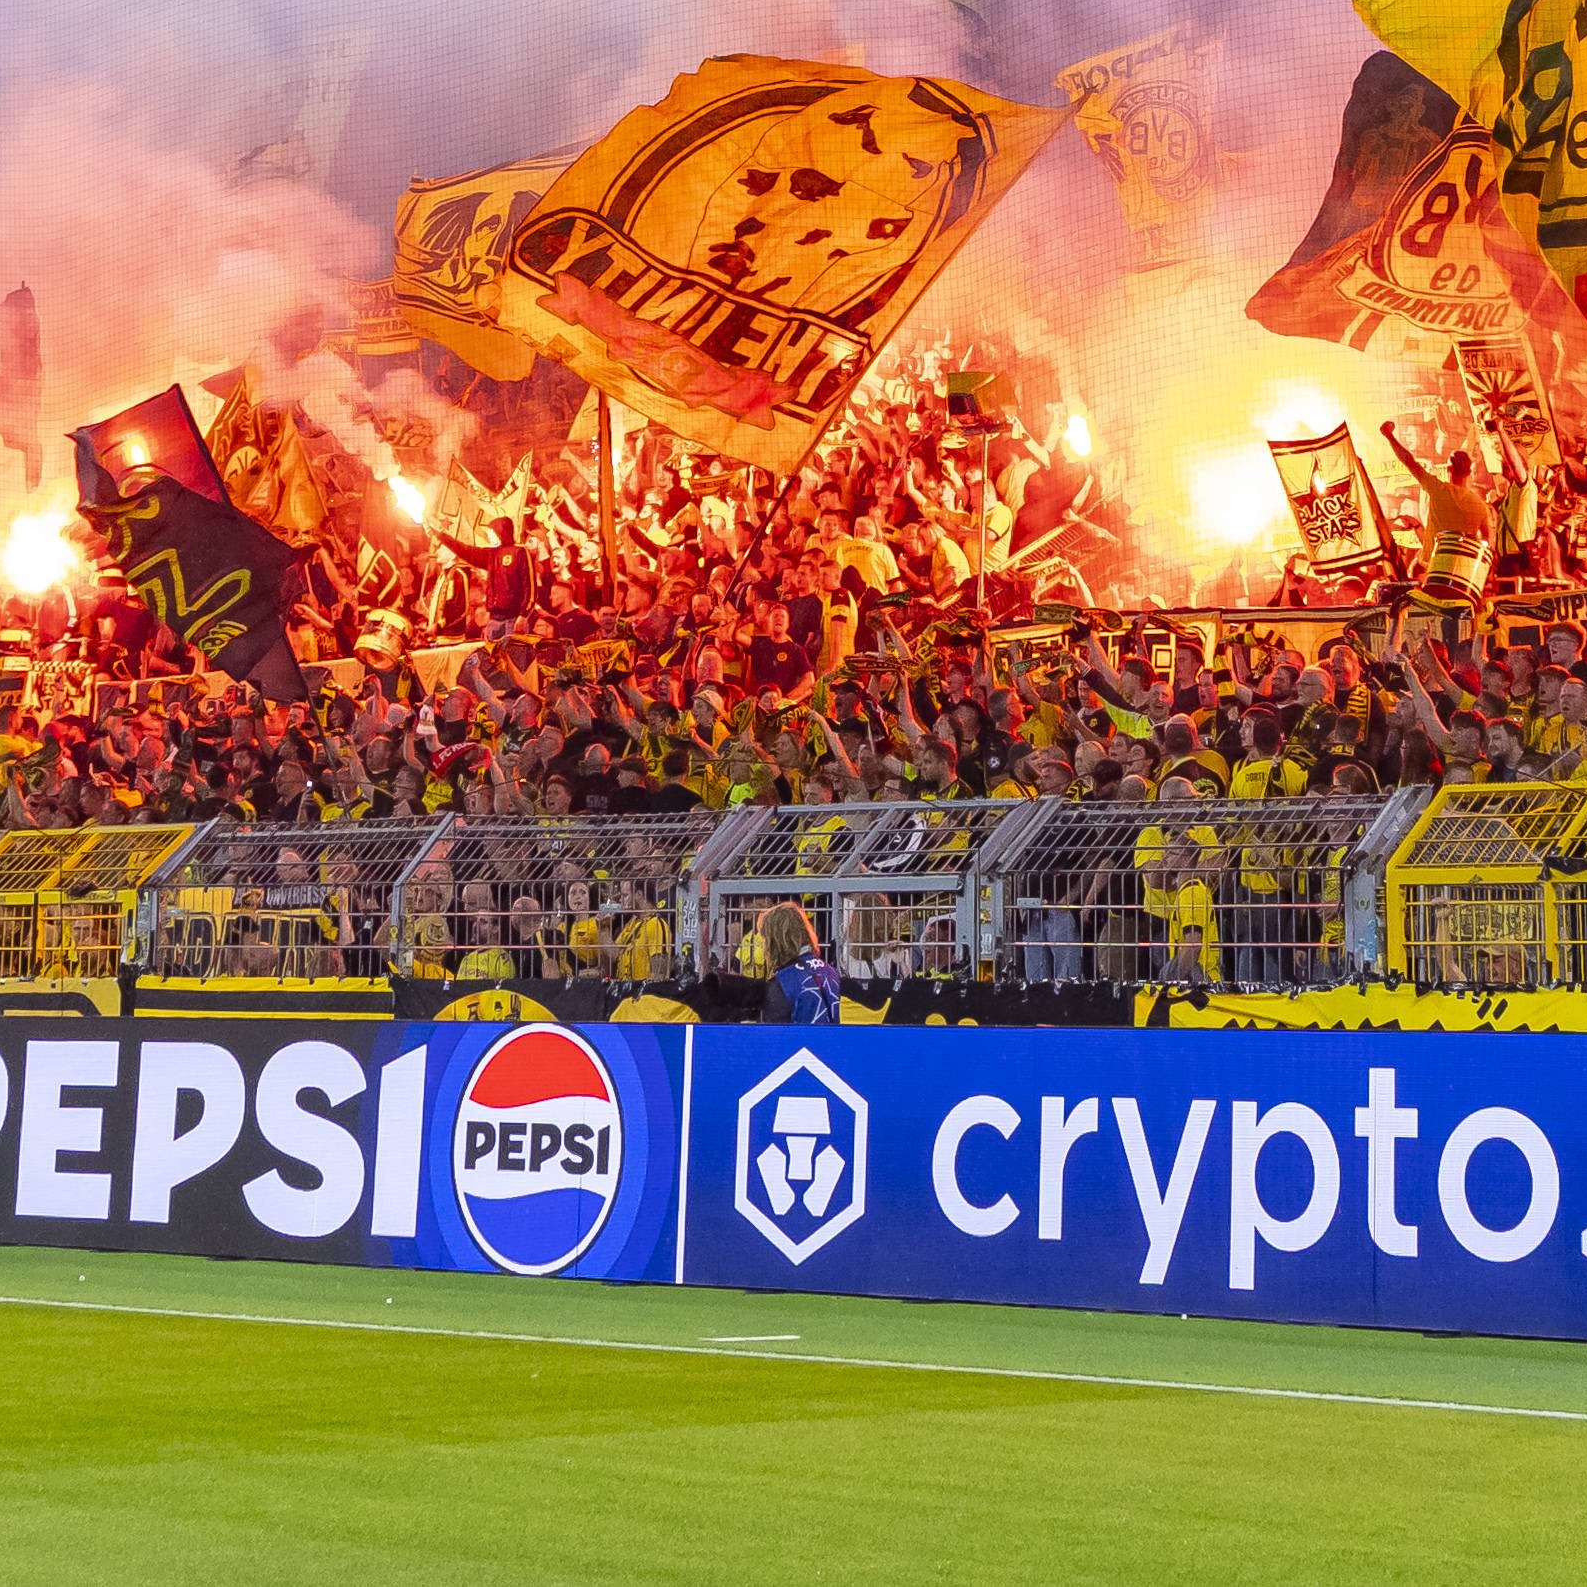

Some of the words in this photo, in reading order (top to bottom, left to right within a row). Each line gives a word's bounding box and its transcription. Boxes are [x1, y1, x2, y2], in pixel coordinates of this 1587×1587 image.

[1298, 494, 1353, 526] BLACK
[1307, 512, 1360, 546] STARS
[463, 1120, 611, 1176] PEPSI
